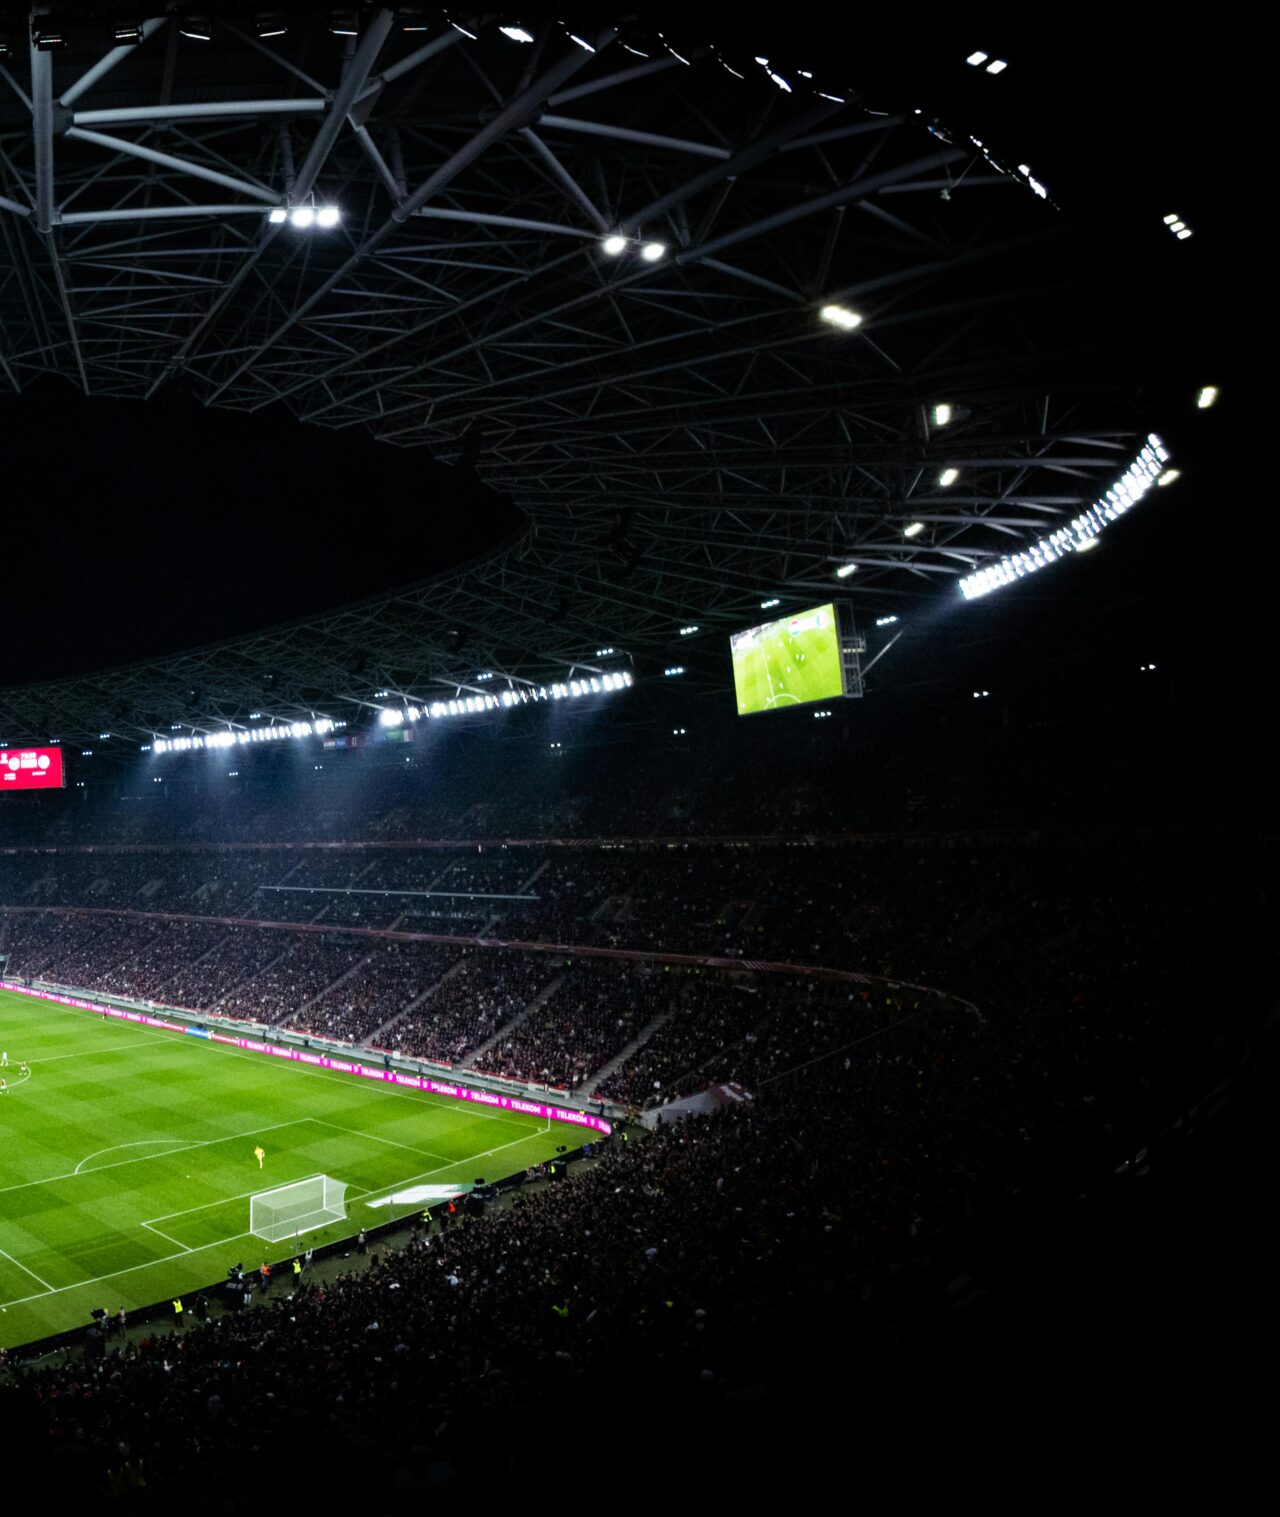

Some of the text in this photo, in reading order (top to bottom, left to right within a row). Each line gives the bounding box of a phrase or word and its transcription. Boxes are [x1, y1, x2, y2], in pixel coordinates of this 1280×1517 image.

[471, 1092, 499, 1104] TELEKOM
[511, 1101, 541, 1114] TELEKOM
[557, 1110, 587, 1123] TELEKOM
